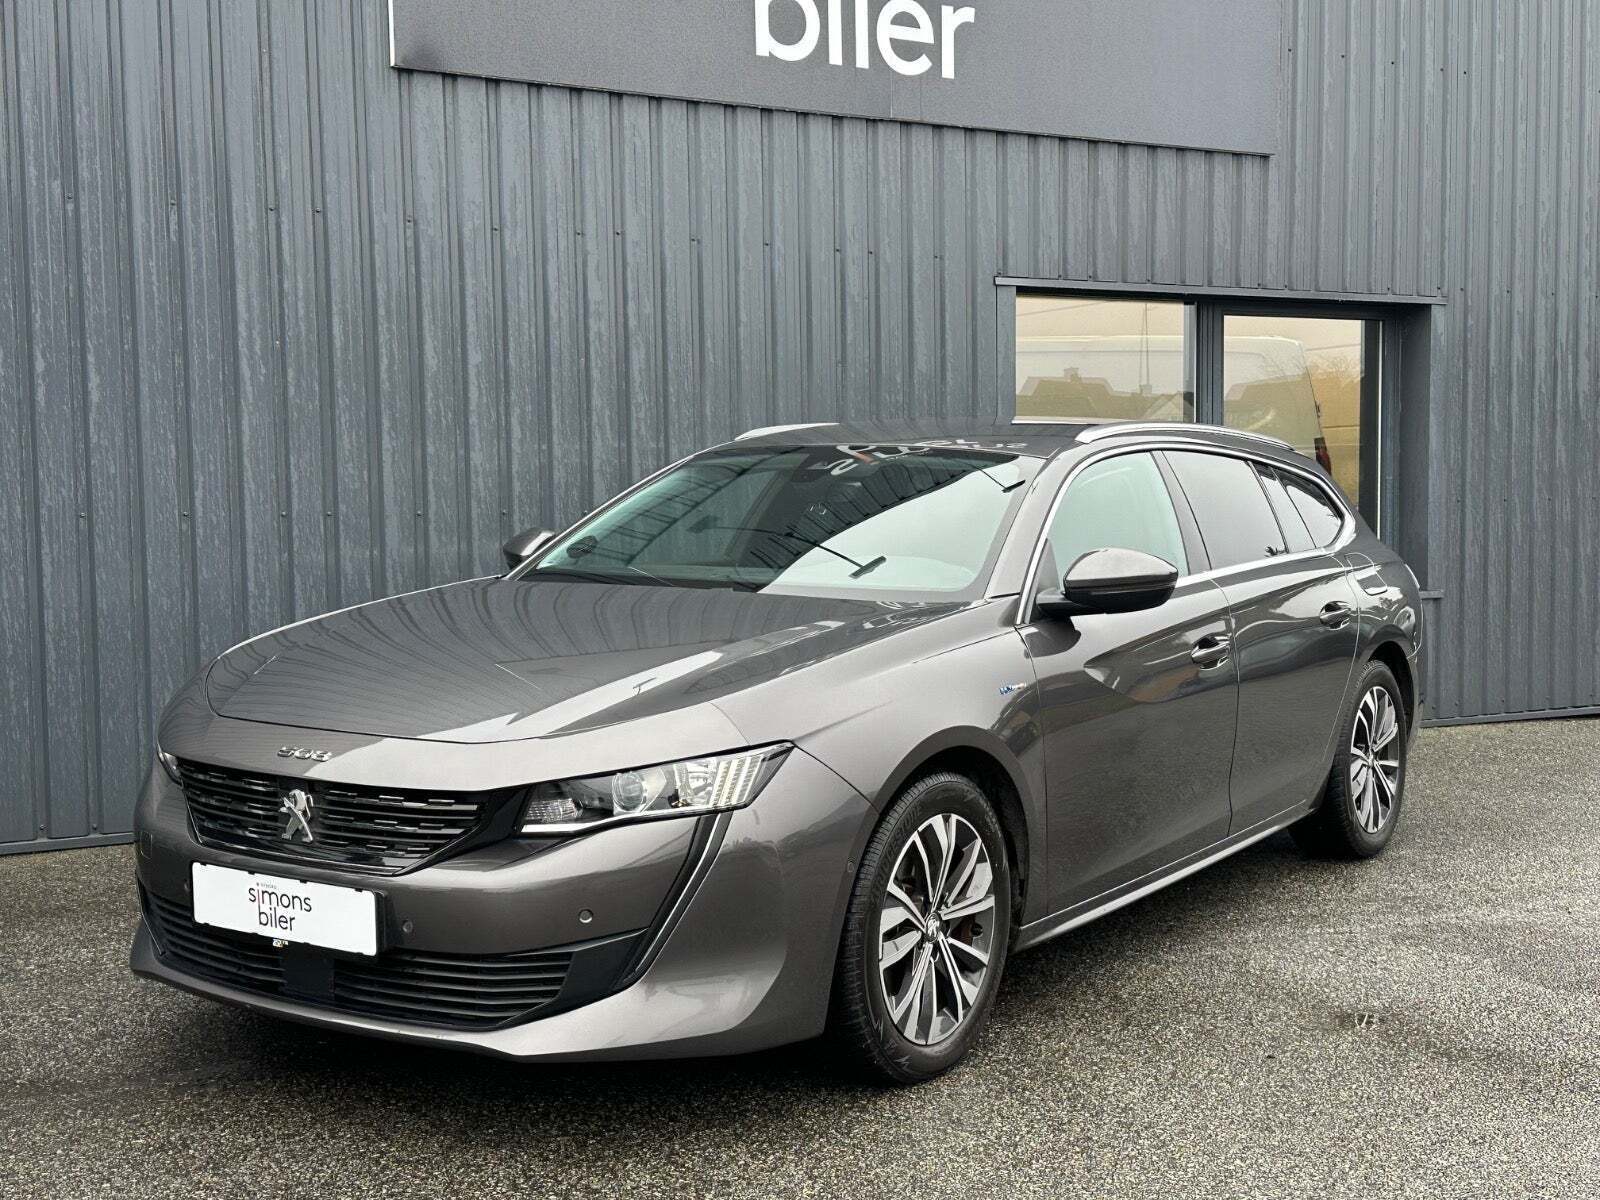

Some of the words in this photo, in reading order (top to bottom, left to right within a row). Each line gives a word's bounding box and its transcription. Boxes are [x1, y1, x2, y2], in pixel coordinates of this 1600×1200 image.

[277, 745, 332, 763] 508
[248, 885, 313, 913] simons
[258, 905, 296, 931] biler
